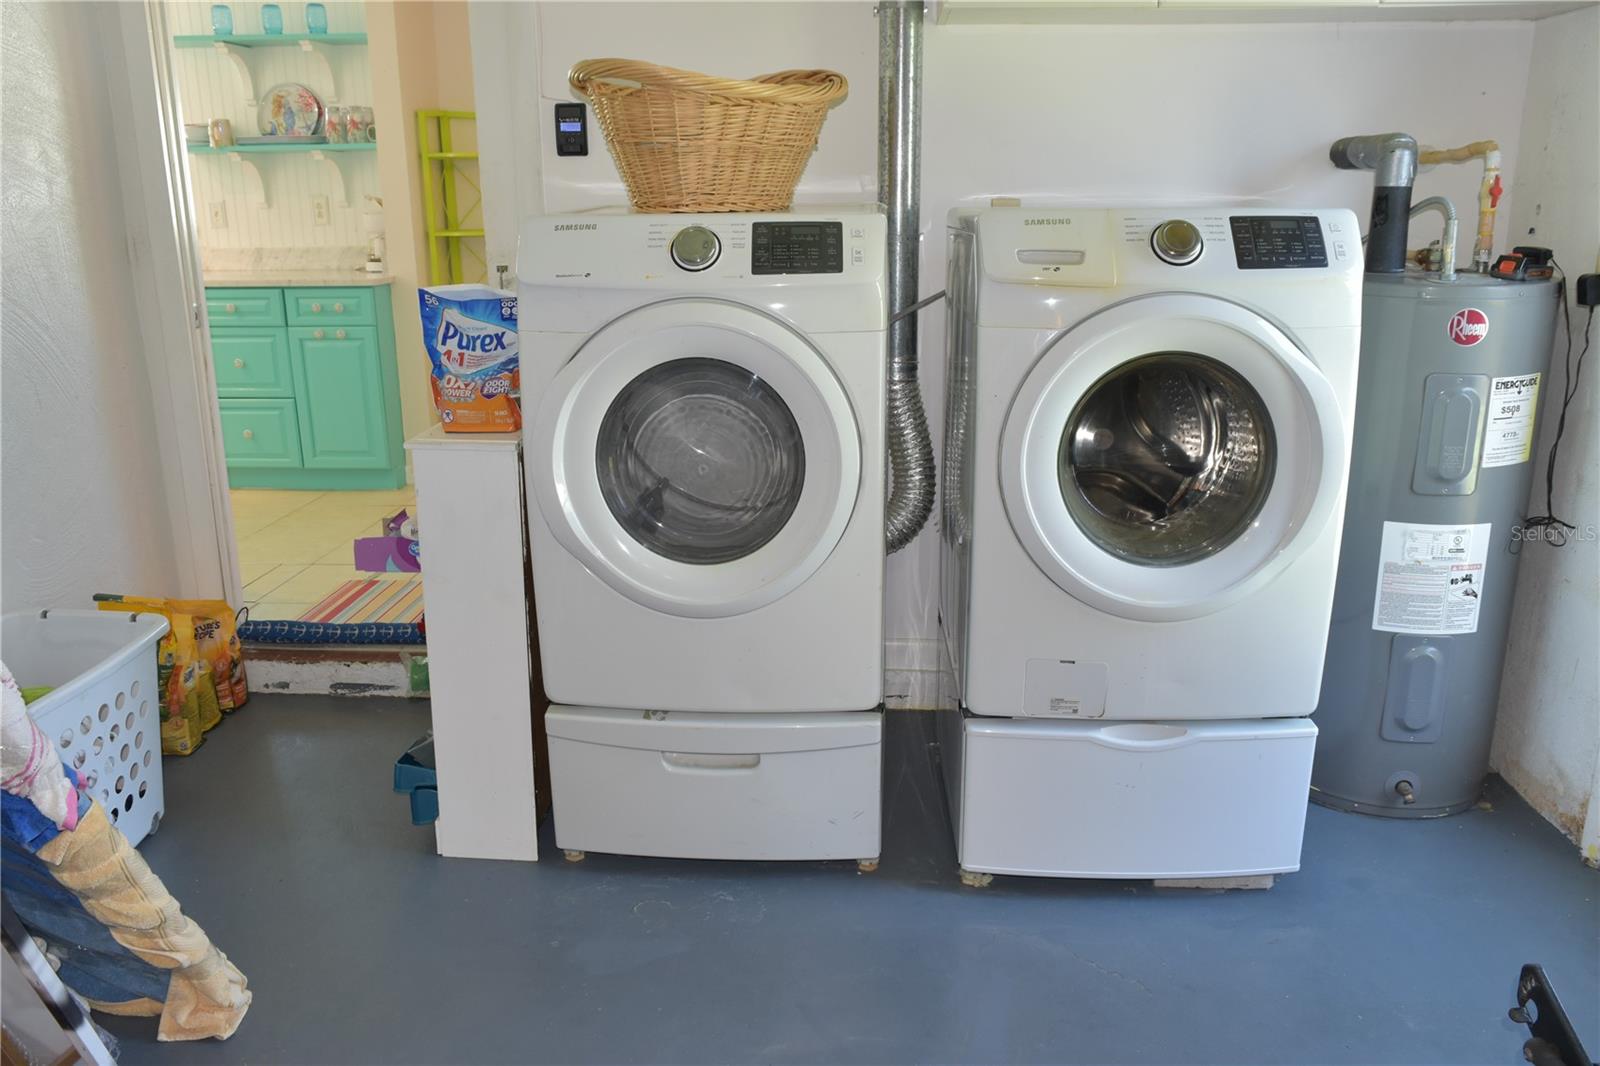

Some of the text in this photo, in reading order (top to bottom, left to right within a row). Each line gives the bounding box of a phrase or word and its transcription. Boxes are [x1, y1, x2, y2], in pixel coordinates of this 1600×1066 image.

[1024, 218, 1071, 226] SAMSUNG
[554, 223, 598, 232] SAMSUNG
[1451, 309, 1487, 341] Rheem
[441, 320, 507, 353] Purex
[485, 379, 510, 388] ODOR
[446, 387, 473, 398] OWER
